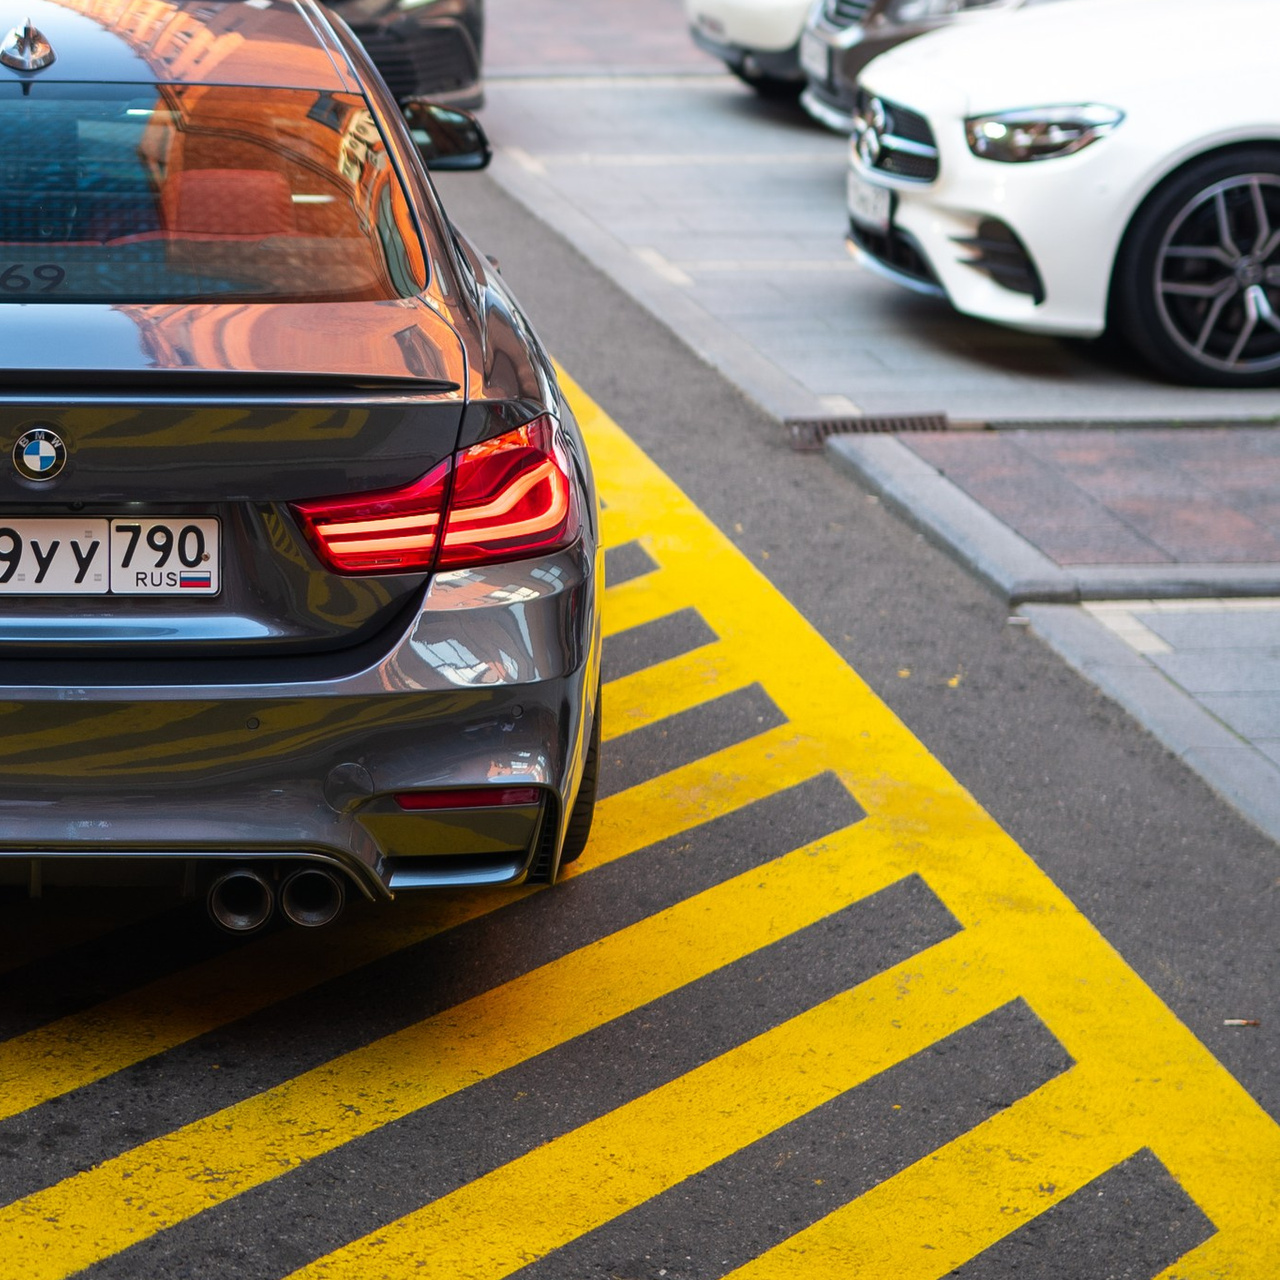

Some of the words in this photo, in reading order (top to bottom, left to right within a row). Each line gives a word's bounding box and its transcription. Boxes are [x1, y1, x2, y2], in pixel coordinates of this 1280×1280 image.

[0, 264, 65, 292] 69
[19, 431, 61, 447] BMW
[115, 524, 205, 568] 790
[135, 571, 177, 587] RUS
